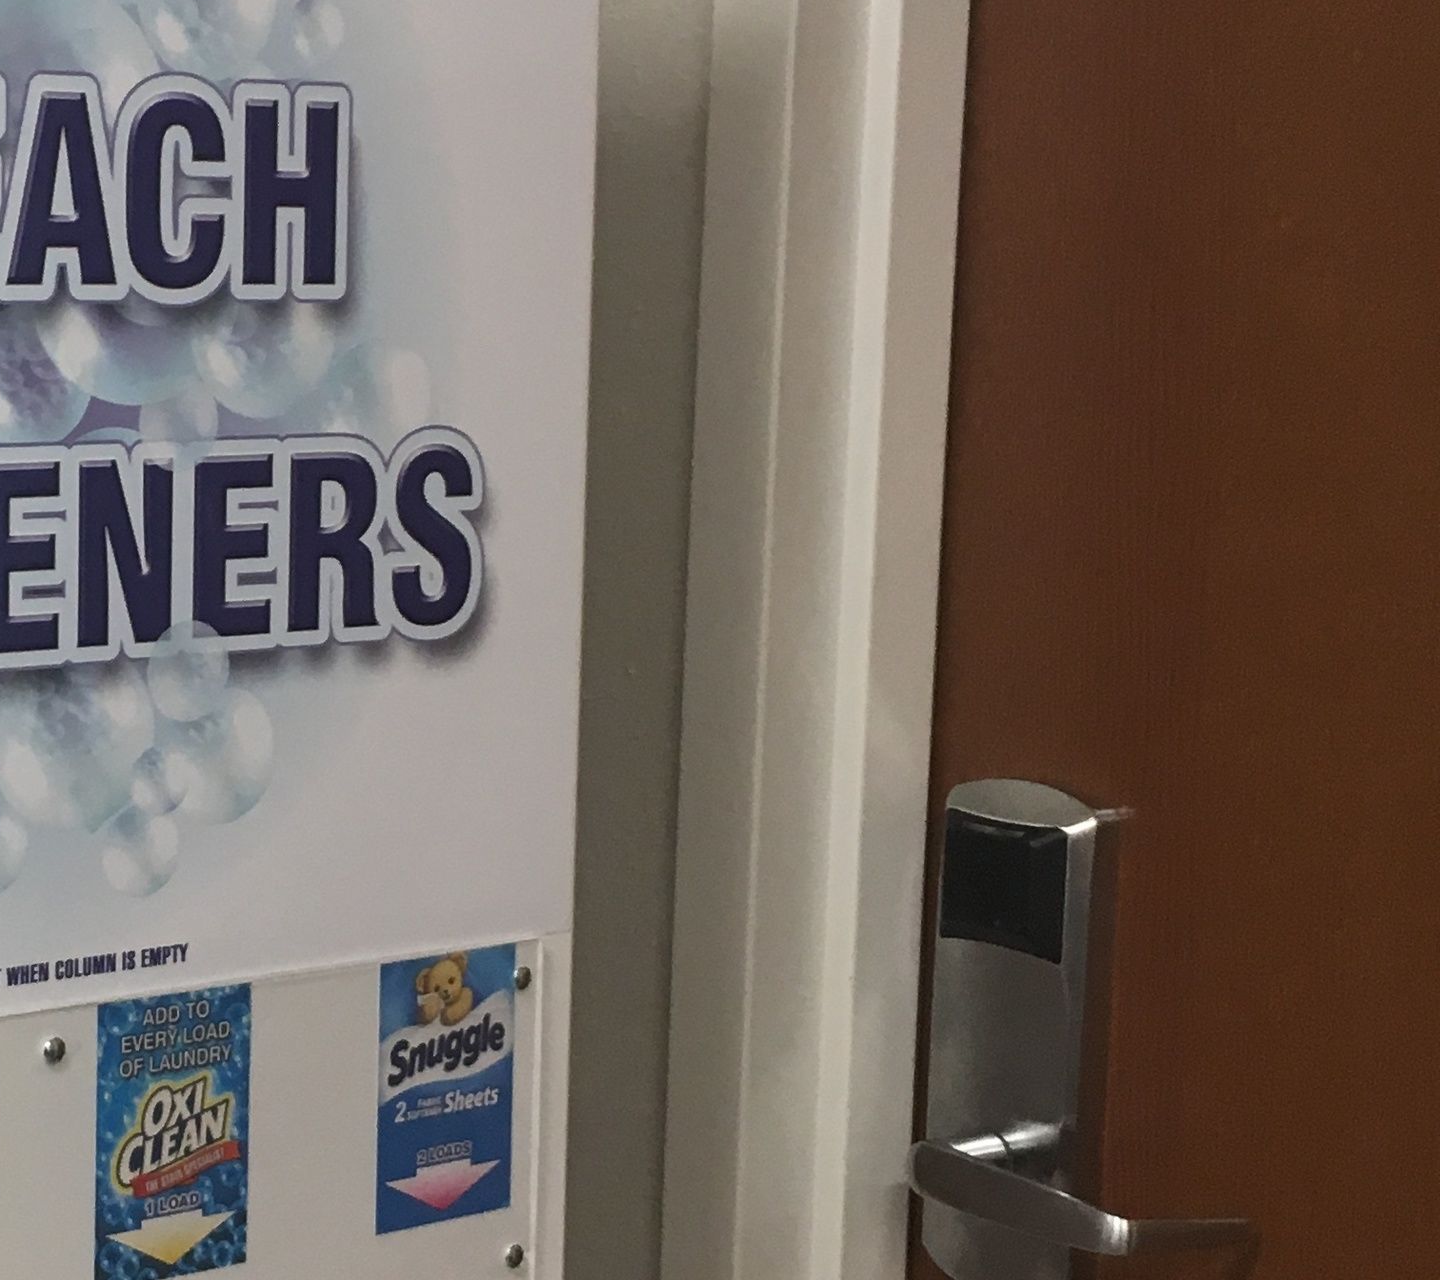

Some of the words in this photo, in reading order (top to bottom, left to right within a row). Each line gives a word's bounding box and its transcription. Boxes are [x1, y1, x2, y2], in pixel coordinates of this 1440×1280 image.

[6, 962, 50, 986] WHEN
[55, 953, 117, 980] COLUMN
[122, 950, 136, 971] IS
[141, 943, 189, 968] EMPTY
[143, 1005, 180, 1026] ADD
[186, 1000, 210, 1019] TO
[121, 1029, 178, 1054] EVERY
[183, 1021, 231, 1044] LOAD
[387, 1012, 506, 1087] Snuggle
[119, 1057, 144, 1078] OF
[149, 1044, 232, 1073] LAUNDRY
[143, 1080, 206, 1138] OXI
[394, 1100, 408, 1124] 2
[443, 1086, 500, 1114] Sheets
[118, 1103, 228, 1186] CLEAN
[428, 1141, 472, 1163] LOADS
[146, 1201, 154, 1215] 1
[159, 1192, 200, 1213] LOAD
